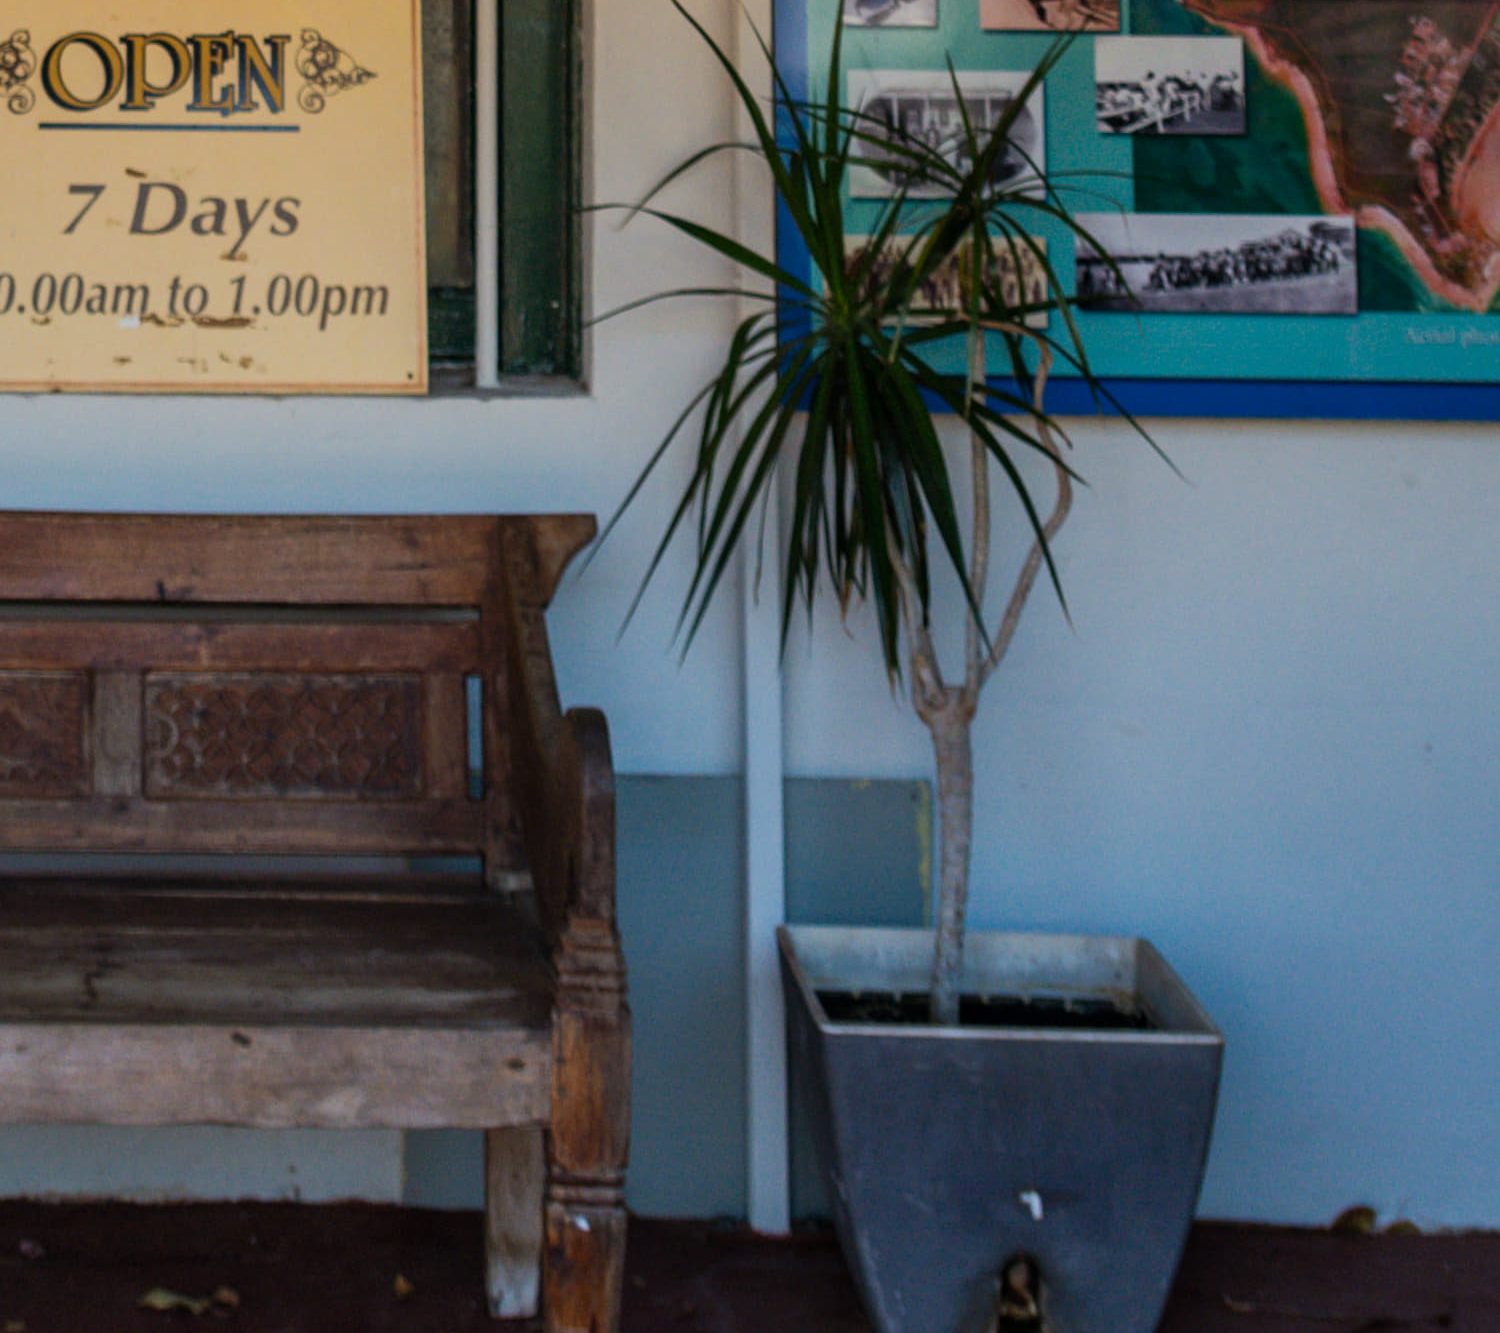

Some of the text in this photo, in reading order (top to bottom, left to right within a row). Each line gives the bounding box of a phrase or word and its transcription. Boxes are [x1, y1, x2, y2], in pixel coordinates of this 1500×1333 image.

[41, 29, 293, 117] OPEN
[62, 181, 302, 259] 7 Days
[168, 274, 209, 316] to
[228, 272, 390, 331] 1.00pm
